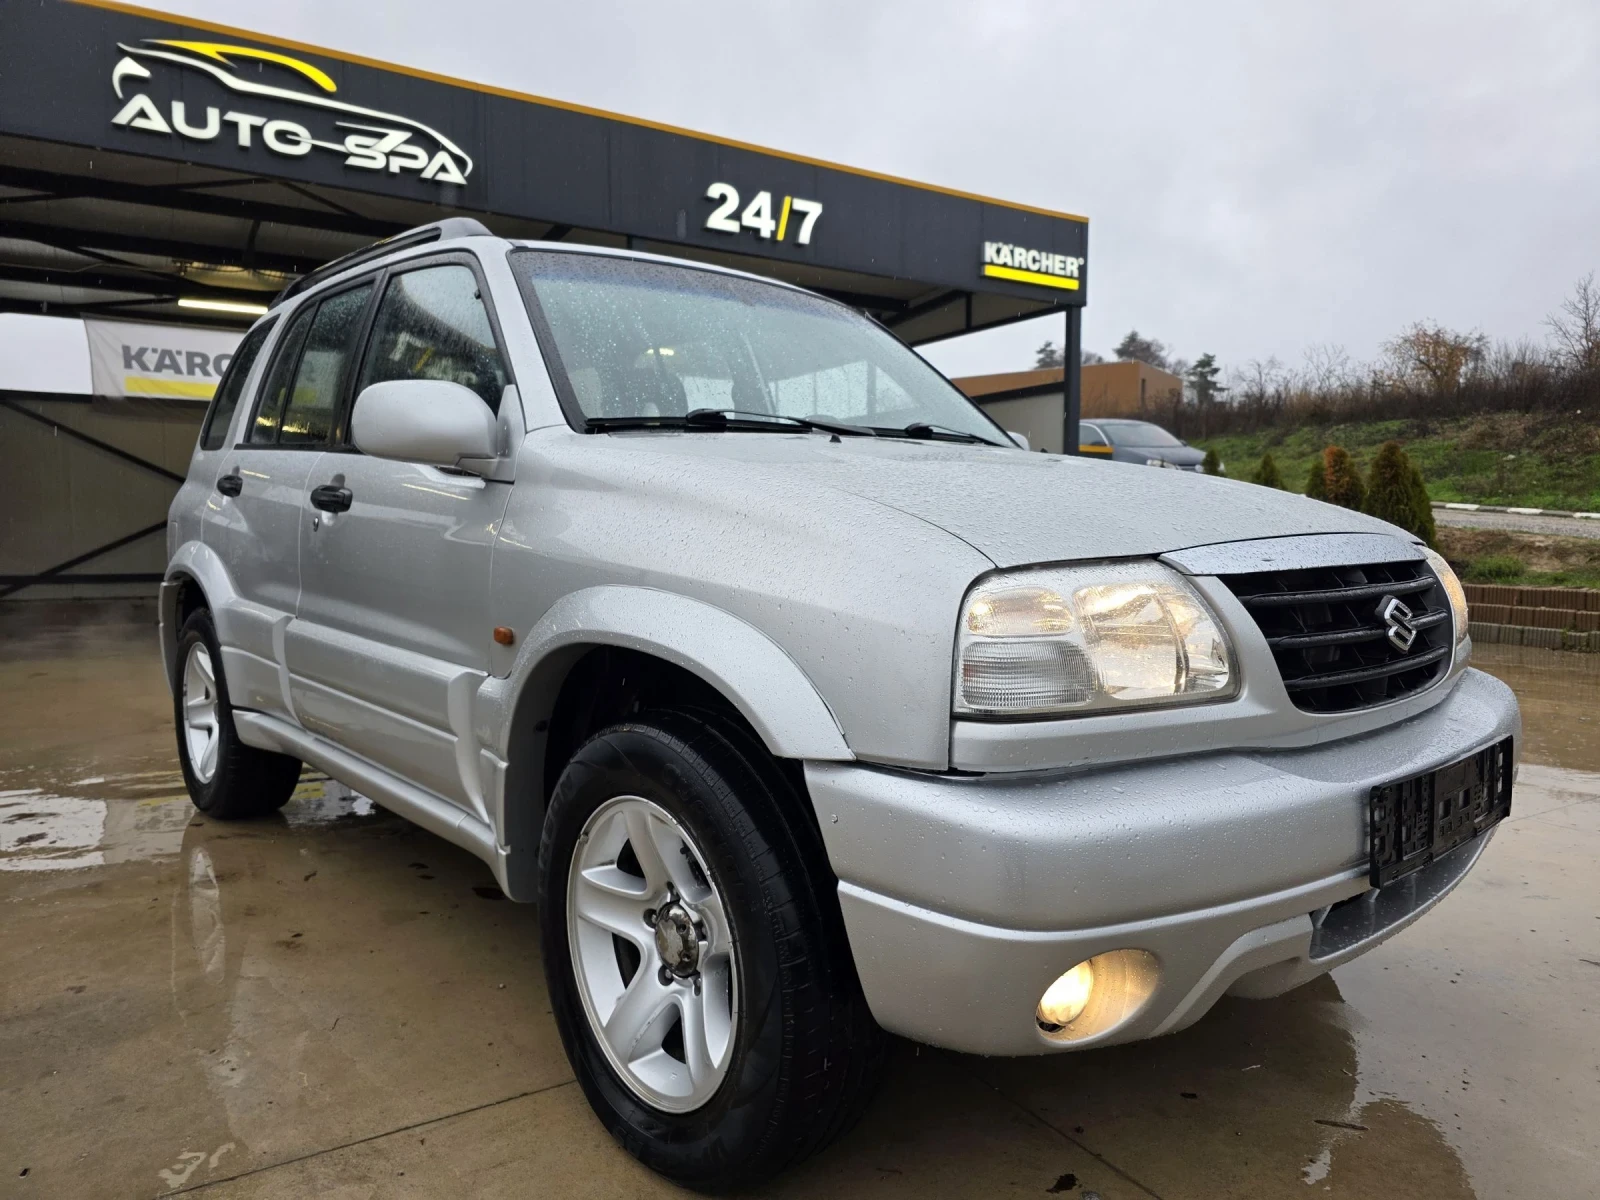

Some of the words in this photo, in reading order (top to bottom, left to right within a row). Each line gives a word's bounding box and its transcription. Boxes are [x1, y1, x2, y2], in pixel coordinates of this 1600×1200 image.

[111, 93, 313, 156] AUTO
[342, 131, 468, 185] SPA
[705, 182, 823, 245] 24/7
